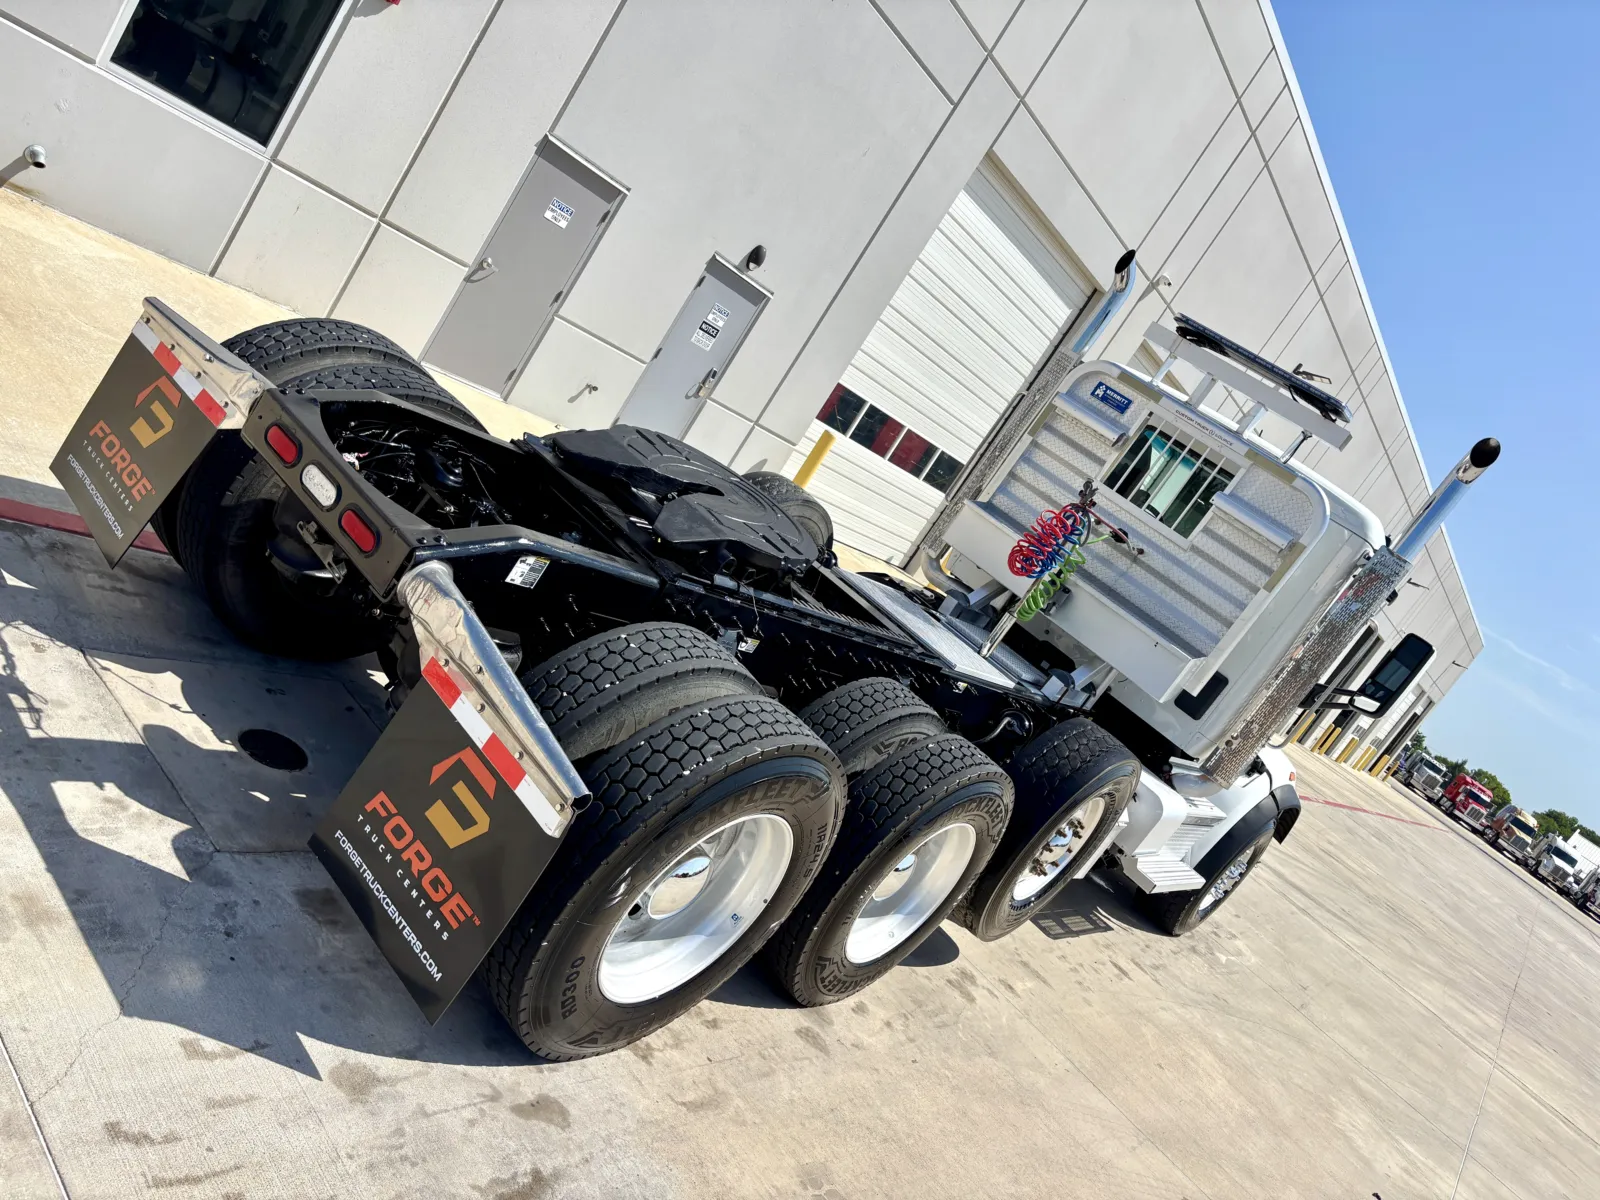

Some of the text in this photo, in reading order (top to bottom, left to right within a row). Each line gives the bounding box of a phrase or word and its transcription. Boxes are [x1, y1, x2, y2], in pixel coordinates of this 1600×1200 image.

[552, 199, 573, 216] NOTICE
[700, 322, 718, 337] NOTICE
[1105, 389, 1129, 405] MERRITT
[1175, 409, 1195, 423] CUSTOM
[1194, 421, 1210, 432] TRUCK
[82, 439, 133, 512] TRUCK CENTERS
[89, 419, 153, 502] FORGE
[67, 453, 125, 540] FORGETRUCKCENTERS.COM
[357, 814, 449, 941] TRUCK CENTERS
[364, 790, 473, 930] FORGE
[803, 823, 828, 878] 11R24.5
[334, 829, 443, 982] FORGETRUCKCENTERS.COM
[561, 956, 586, 1020] RD300
